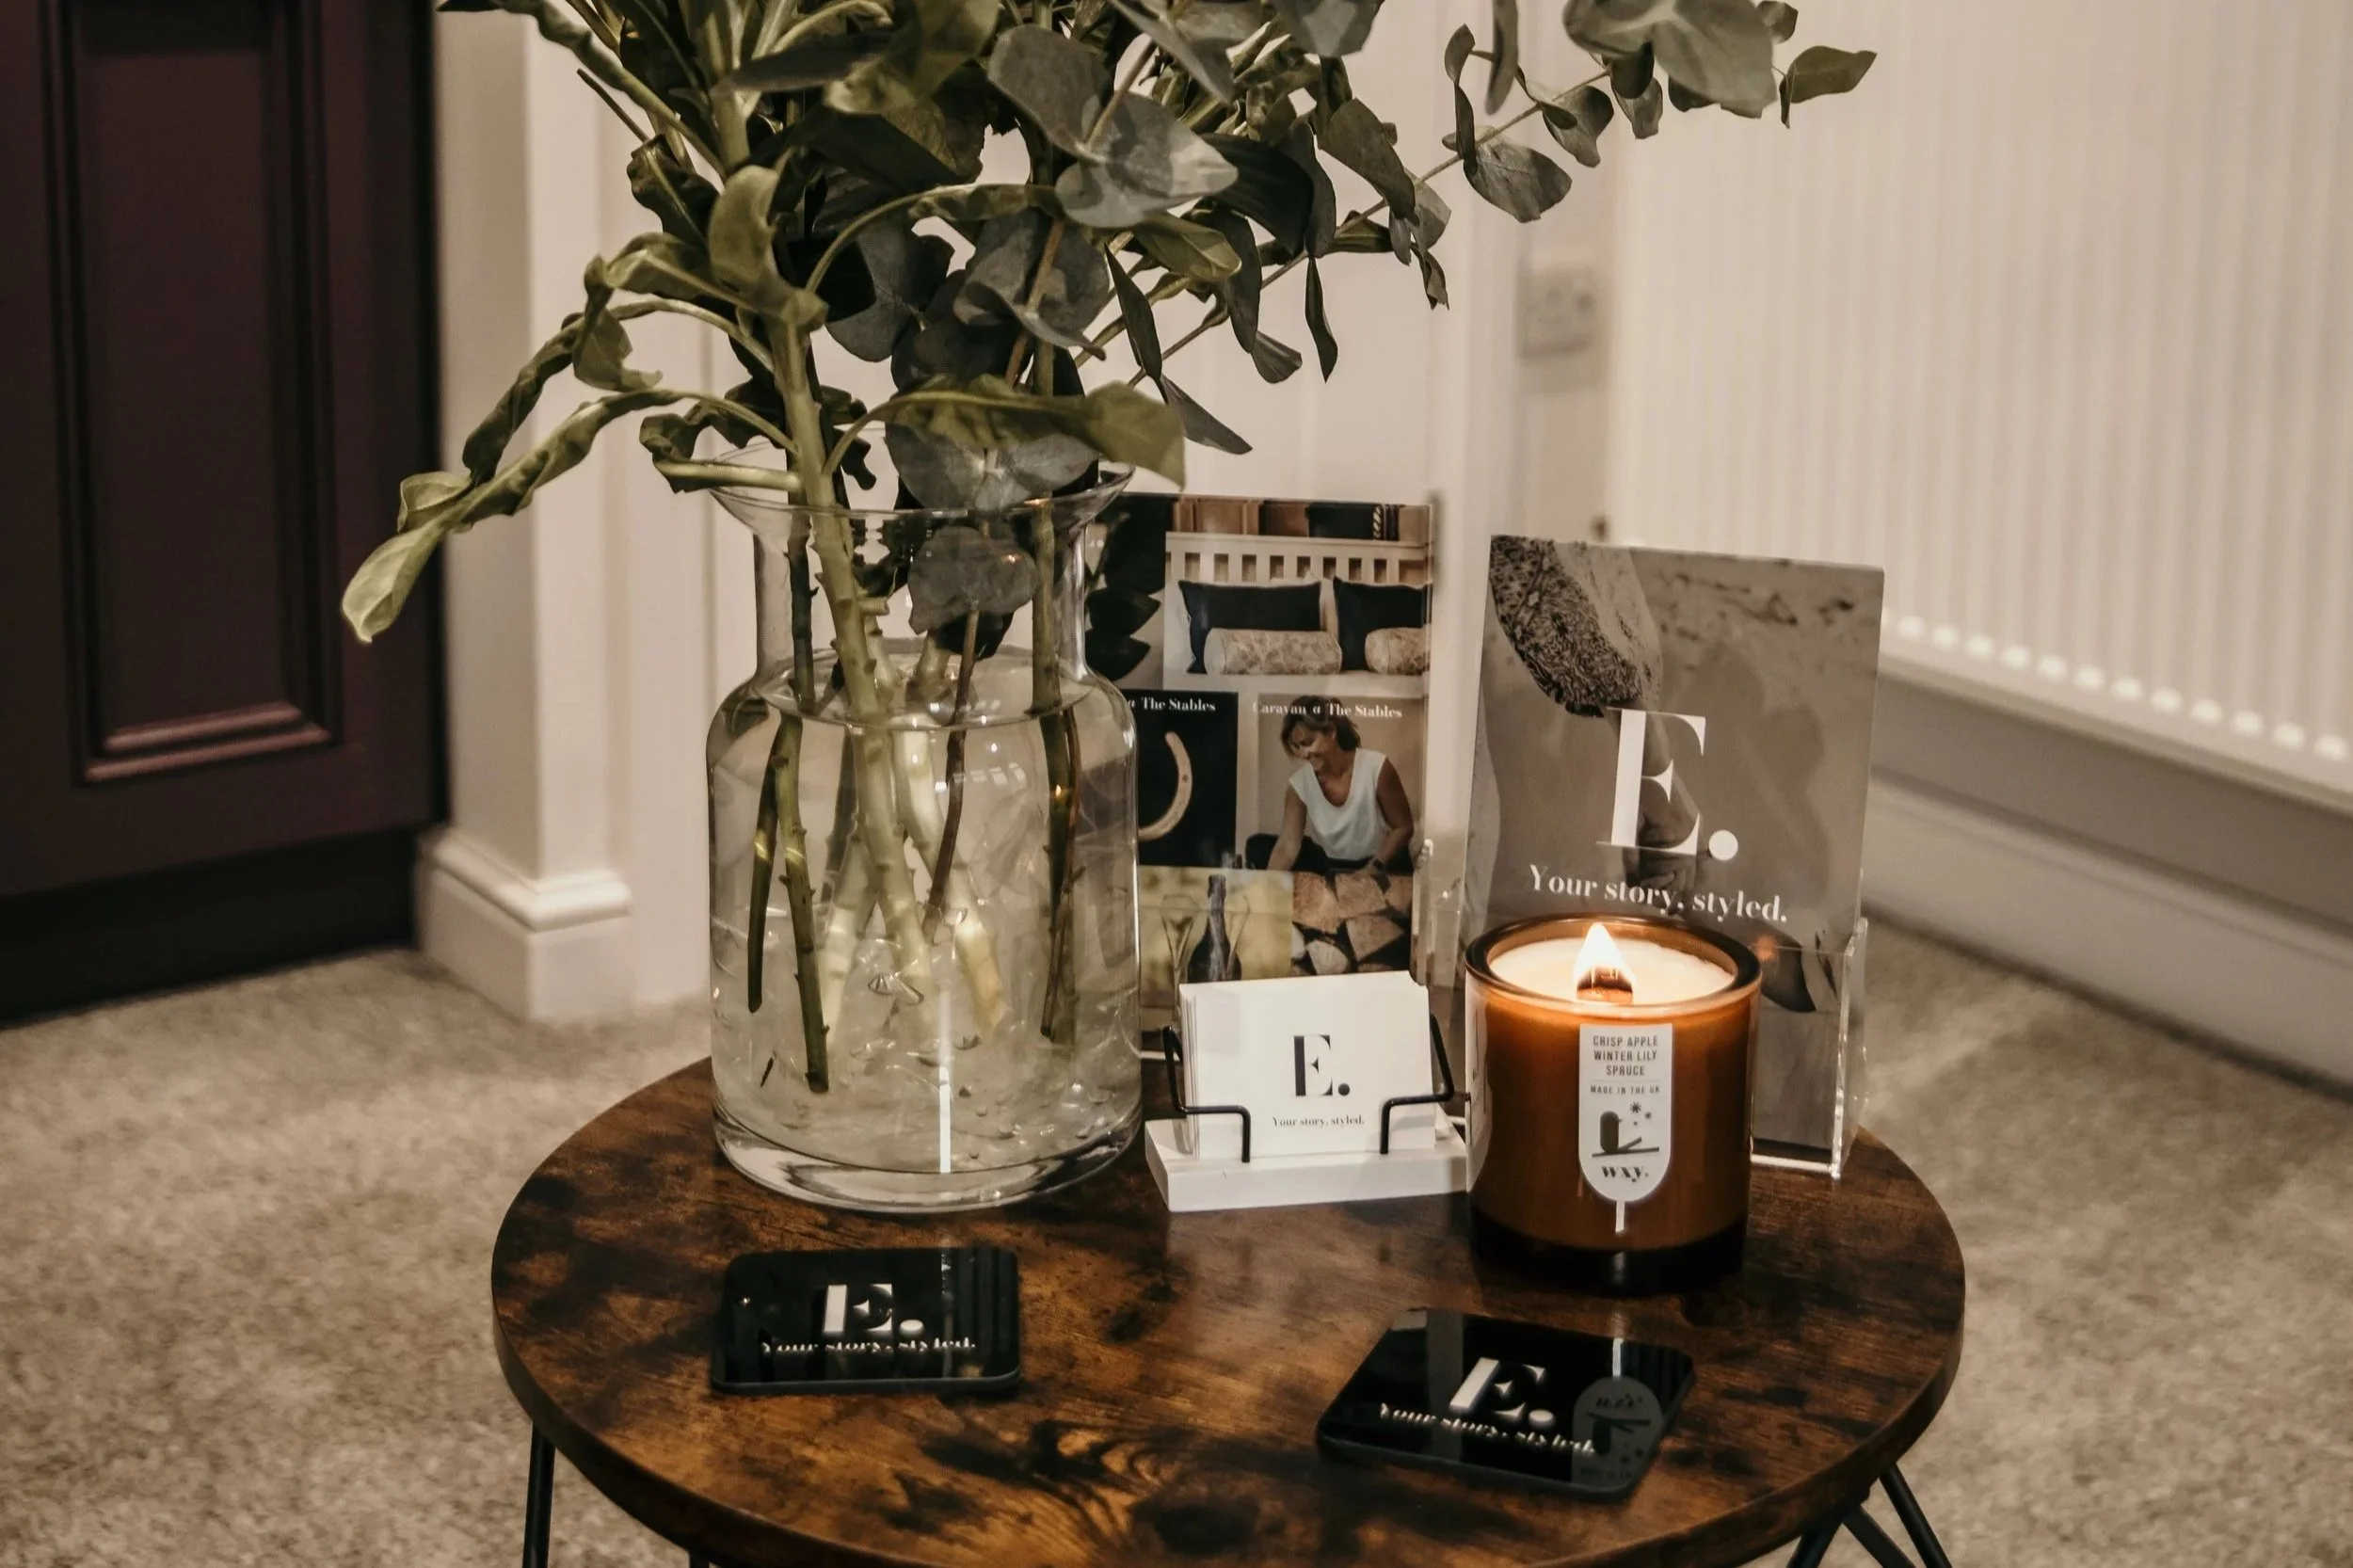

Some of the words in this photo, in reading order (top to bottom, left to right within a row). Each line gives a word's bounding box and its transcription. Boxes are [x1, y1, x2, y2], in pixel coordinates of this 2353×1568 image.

[1141, 696, 1166, 710] The
[1169, 697, 1216, 712] Stables
[1327, 702, 1352, 716] The
[1353, 703, 1403, 718] Stables
[1596, 706, 1739, 862] E.
[1529, 864, 1598, 897] Your
[1604, 877, 1685, 915] story,
[1692, 889, 1788, 922] styled.
[1593, 1035, 1623, 1047] CRISP
[1627, 1035, 1658, 1047] APPLE
[1594, 1049, 1633, 1062] WINTER
[1637, 1049, 1657, 1062] LILY
[1290, 1033, 1351, 1096] E.
[1606, 1064, 1645, 1076] SPRUCE
[1590, 1085, 1612, 1094] MADE
[1617, 1085, 1626, 1095] IN
[1630, 1085, 1645, 1095] THE
[1649, 1085, 1660, 1094] UK
[1273, 1116, 1297, 1128] Your
[1300, 1116, 1328, 1127] story,
[1332, 1114, 1365, 1126] styled.
